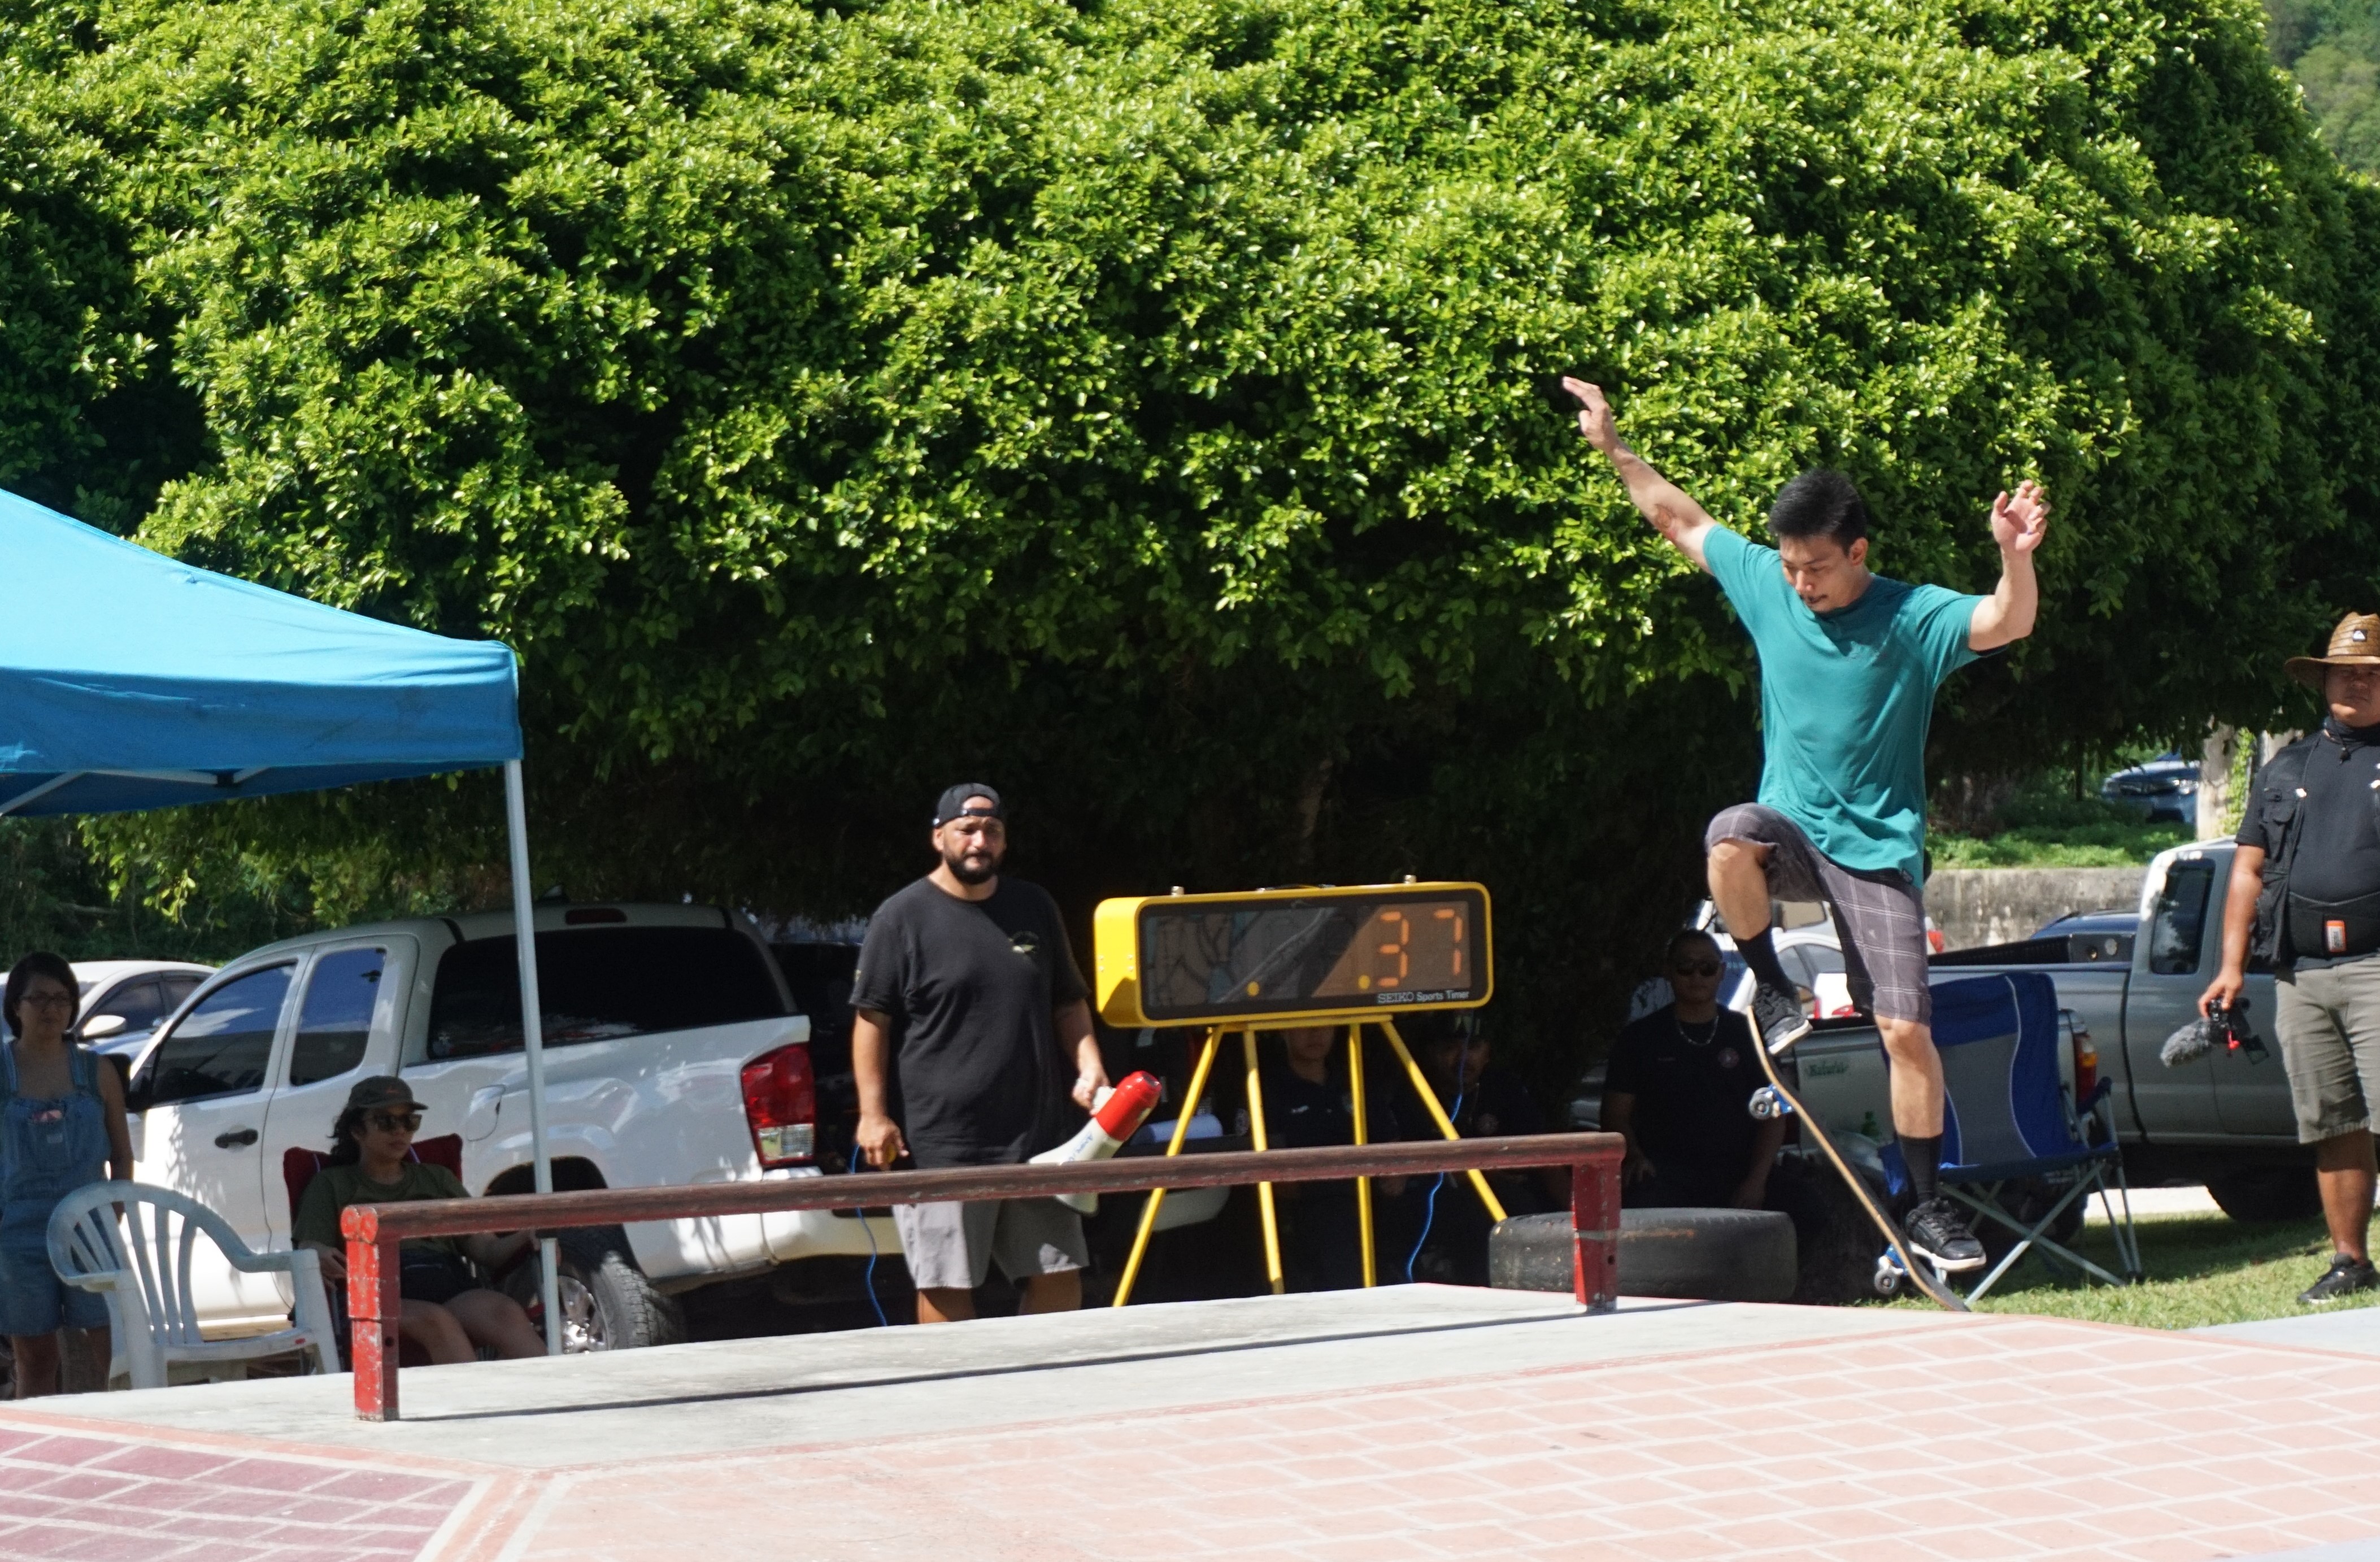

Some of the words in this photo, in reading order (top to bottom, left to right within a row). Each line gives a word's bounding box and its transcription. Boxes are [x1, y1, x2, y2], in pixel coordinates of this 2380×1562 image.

[1376, 991, 1414, 1004] SEIKO
[1416, 991, 1443, 1002] Sports
[1445, 989, 1469, 1000] Timer
